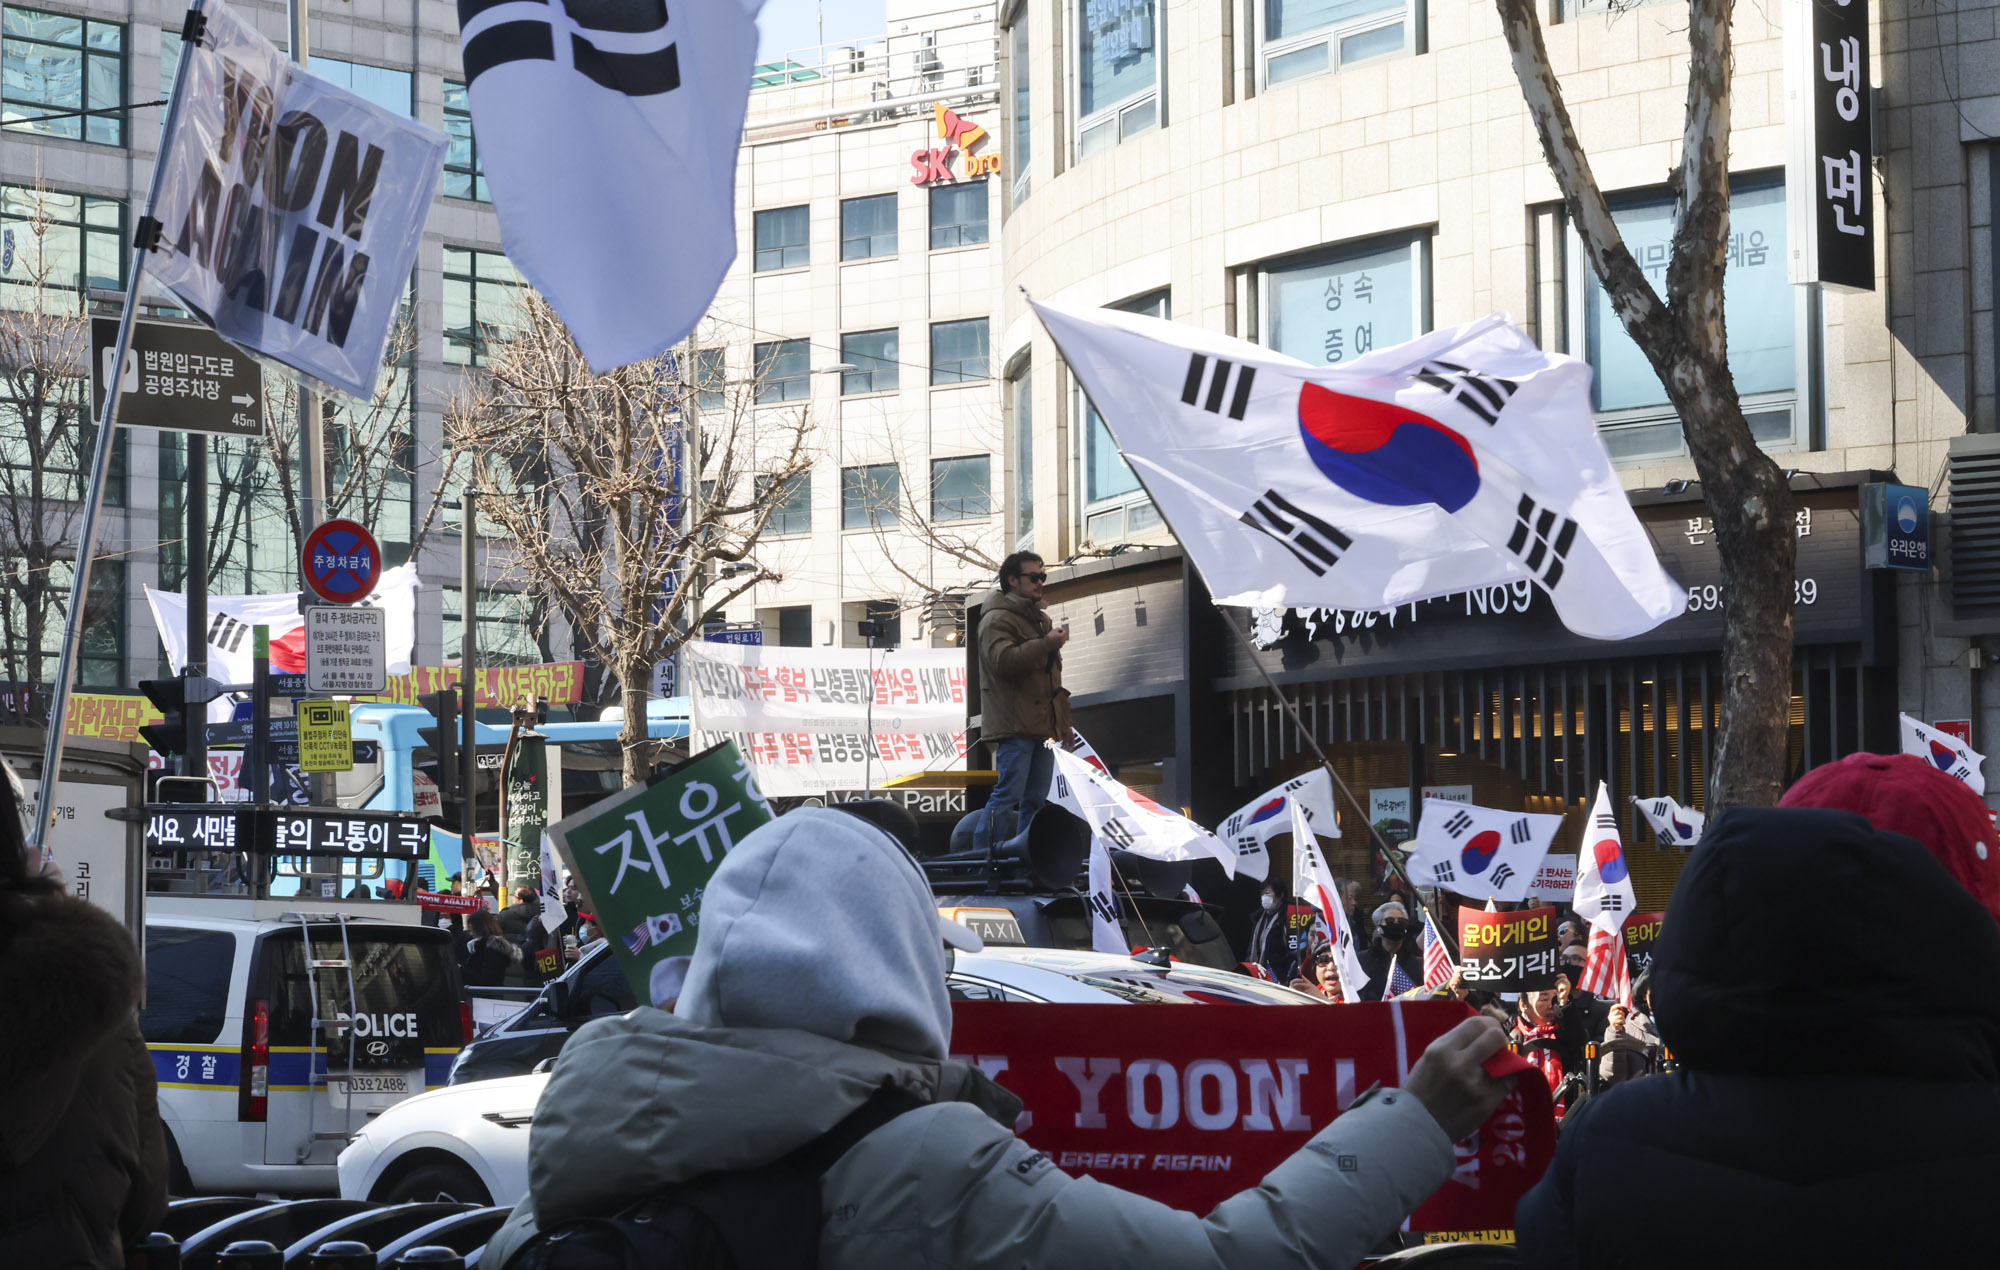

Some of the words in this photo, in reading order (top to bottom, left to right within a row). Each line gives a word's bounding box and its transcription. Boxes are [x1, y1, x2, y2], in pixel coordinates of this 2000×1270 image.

[910, 145, 953, 184] SK
[144, 350, 235, 378] 법원입구도로
[144, 374, 221, 400] 공영주차장
[231, 413, 256, 428] 45m
[1889, 538, 1927, 559] 우리은행
[314, 555, 370, 570] 주정차금지
[315, 612, 329, 624] 절대
[903, 790, 966, 812] Parki
[321, 820, 389, 852] 고통이
[970, 921, 1015, 940] TAXI
[1463, 914, 1548, 948] 윤어게인
[1462, 948, 1556, 981] 공소기각!
[336, 1012, 418, 1038] POLICE
[176, 1055, 217, 1080] 경찰
[375, 1078, 404, 1092] 2488
[1059, 1151, 1146, 1170] GREAT
[1152, 1153, 1233, 1172] AGAIN
